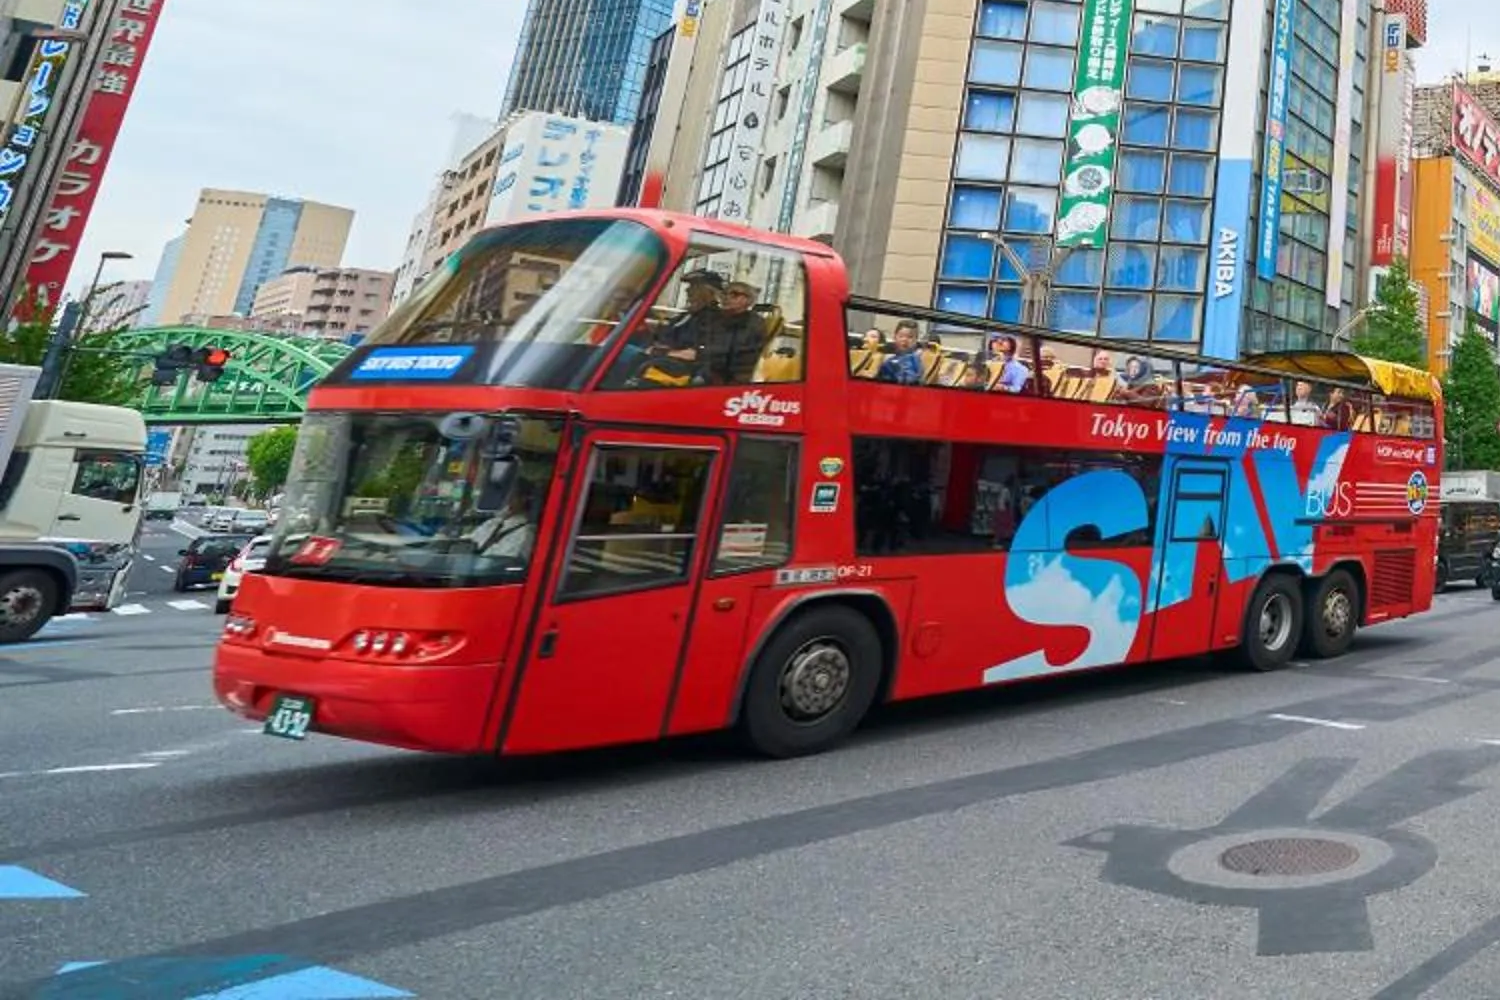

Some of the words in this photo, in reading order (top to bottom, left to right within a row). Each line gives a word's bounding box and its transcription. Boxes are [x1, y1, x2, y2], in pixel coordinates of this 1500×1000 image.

[1214, 227, 1238, 297] AKIBA
[722, 390, 773, 417] SKY
[770, 400, 800, 414] BUS
[1091, 413, 1149, 445] Tokyo
[1156, 423, 1199, 444] View
[1202, 426, 1242, 449] from
[1246, 430, 1271, 450] the
[1272, 436, 1297, 455] top
[1306, 482, 1352, 518] BUS
